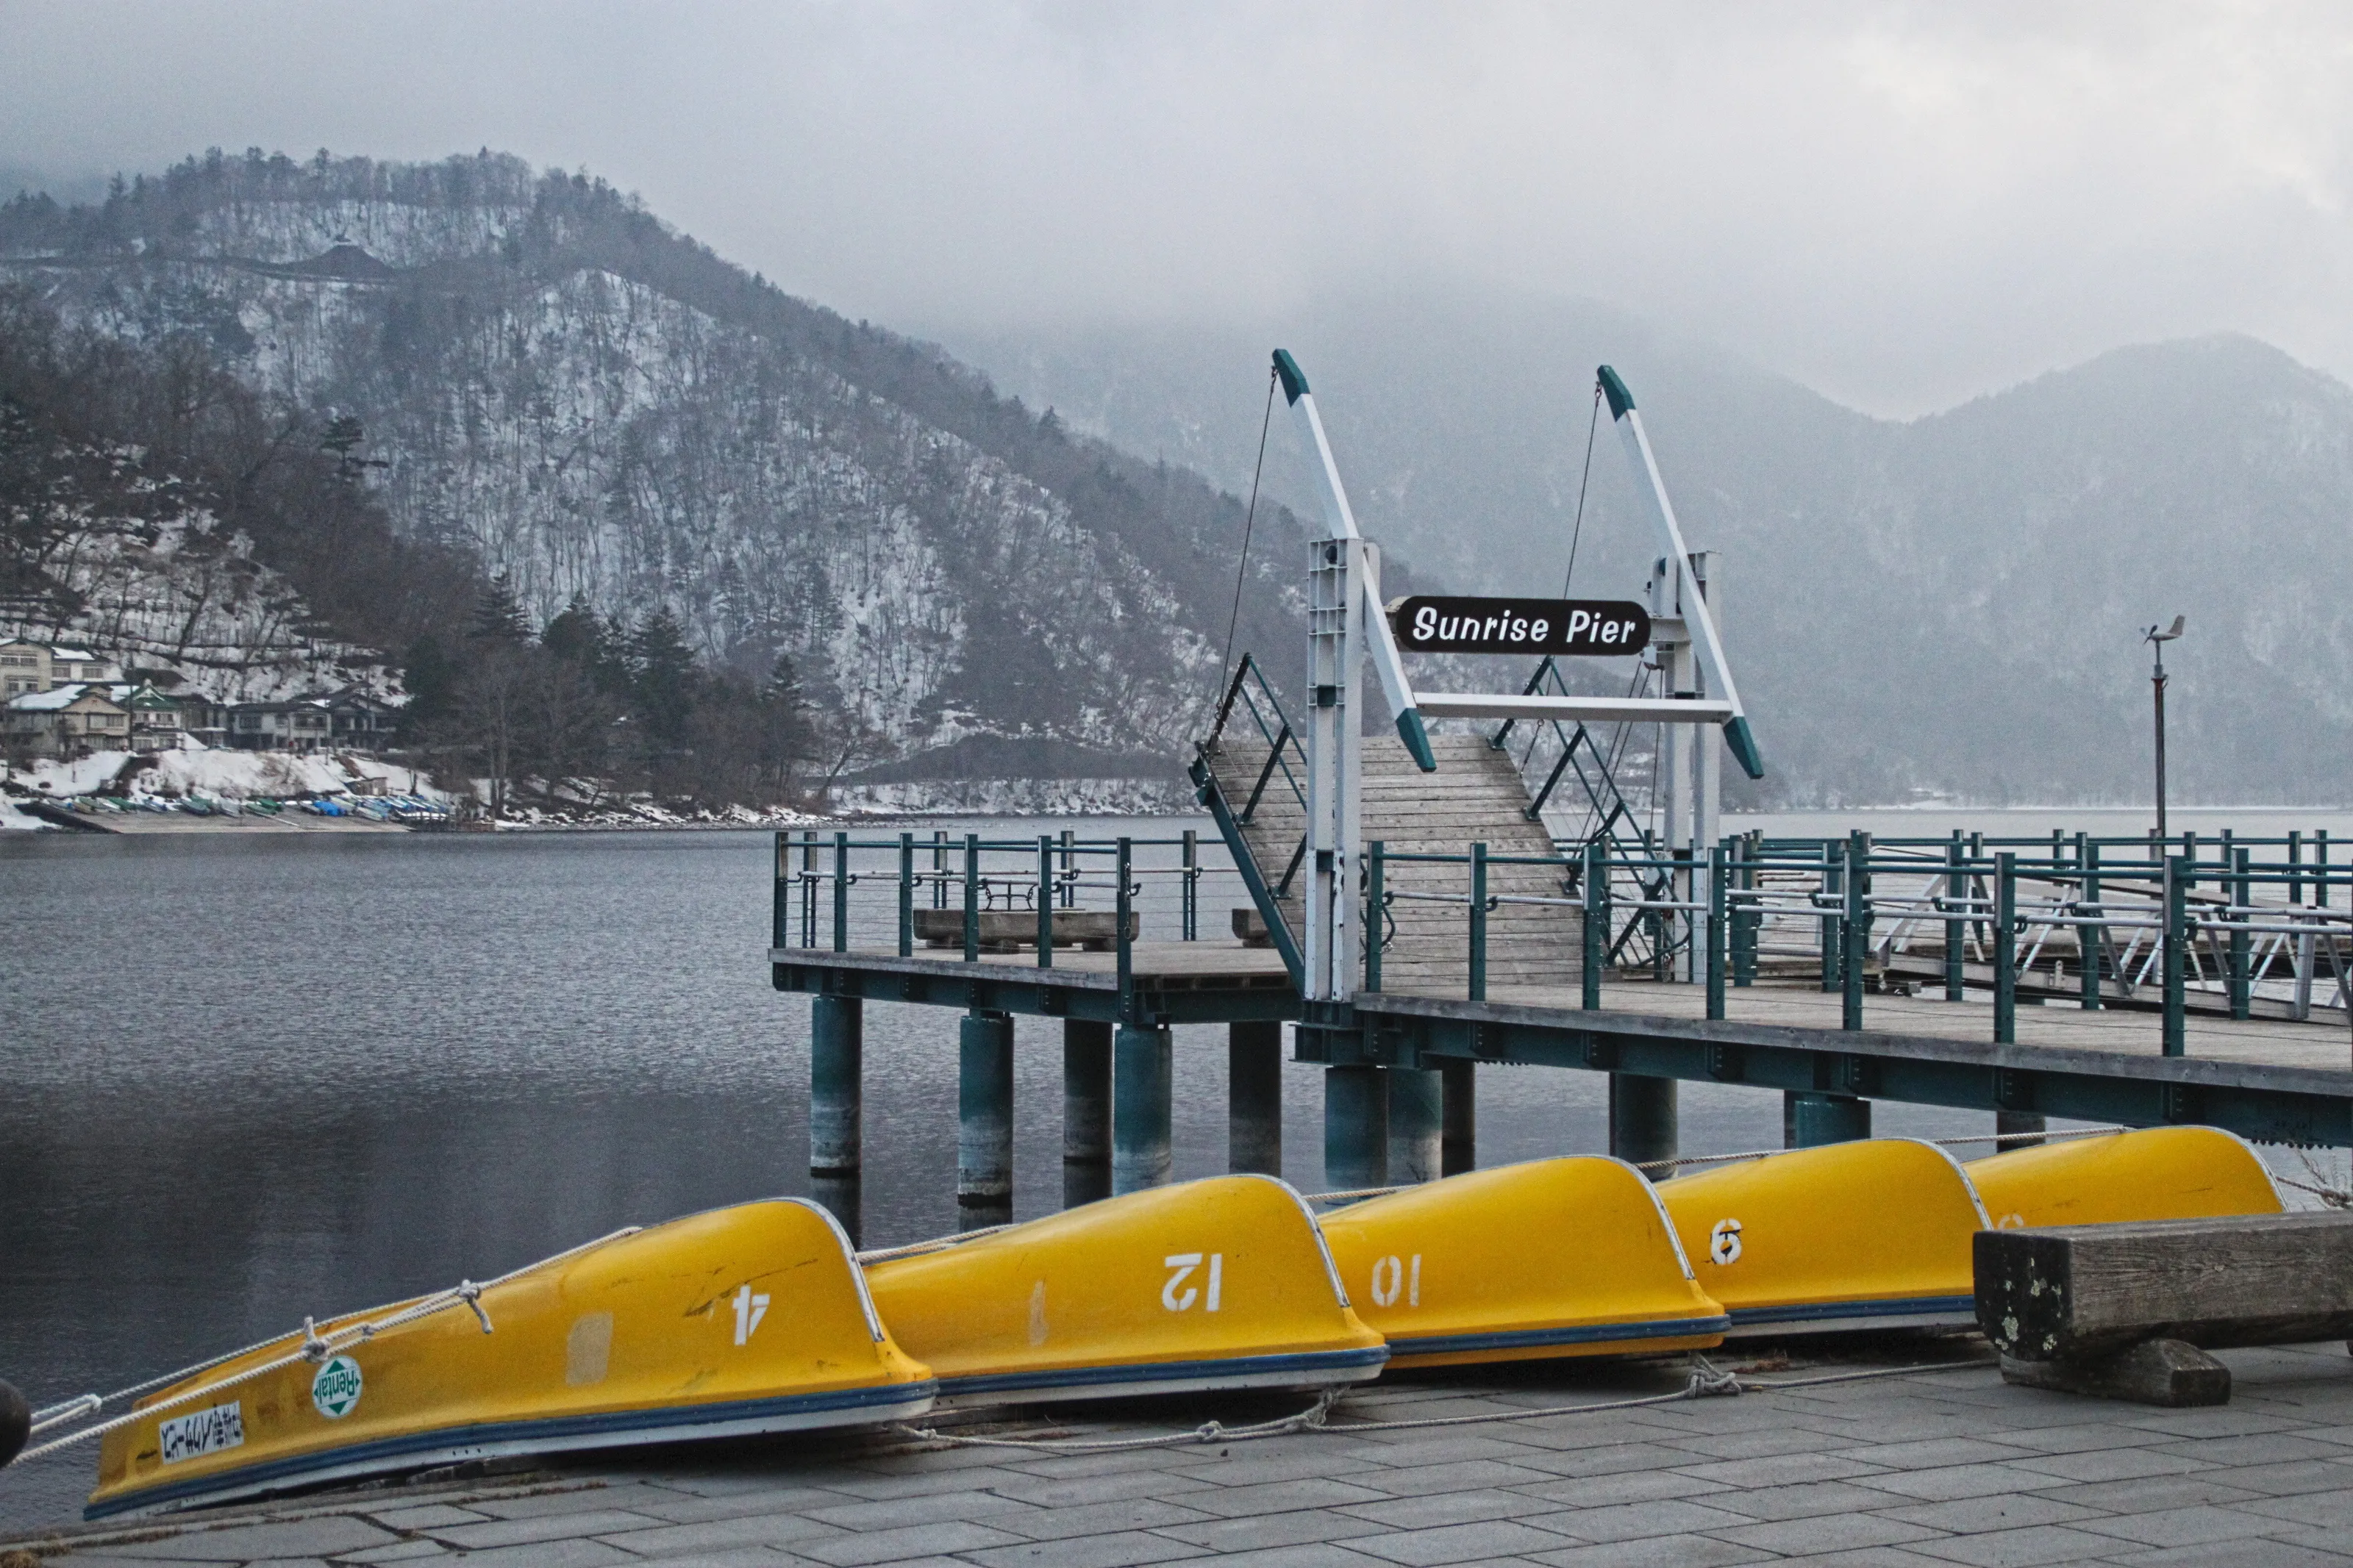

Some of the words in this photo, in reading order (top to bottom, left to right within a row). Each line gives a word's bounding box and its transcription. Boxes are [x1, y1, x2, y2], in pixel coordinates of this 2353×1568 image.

[1413, 606, 1549, 641] Sunrise
[1566, 609, 1635, 643] Pier
[1162, 1253, 1222, 1312] 12
[1371, 1254, 1421, 1306] 10
[732, 1285, 770, 1345] 4
[318, 1370, 357, 1403] Rental
